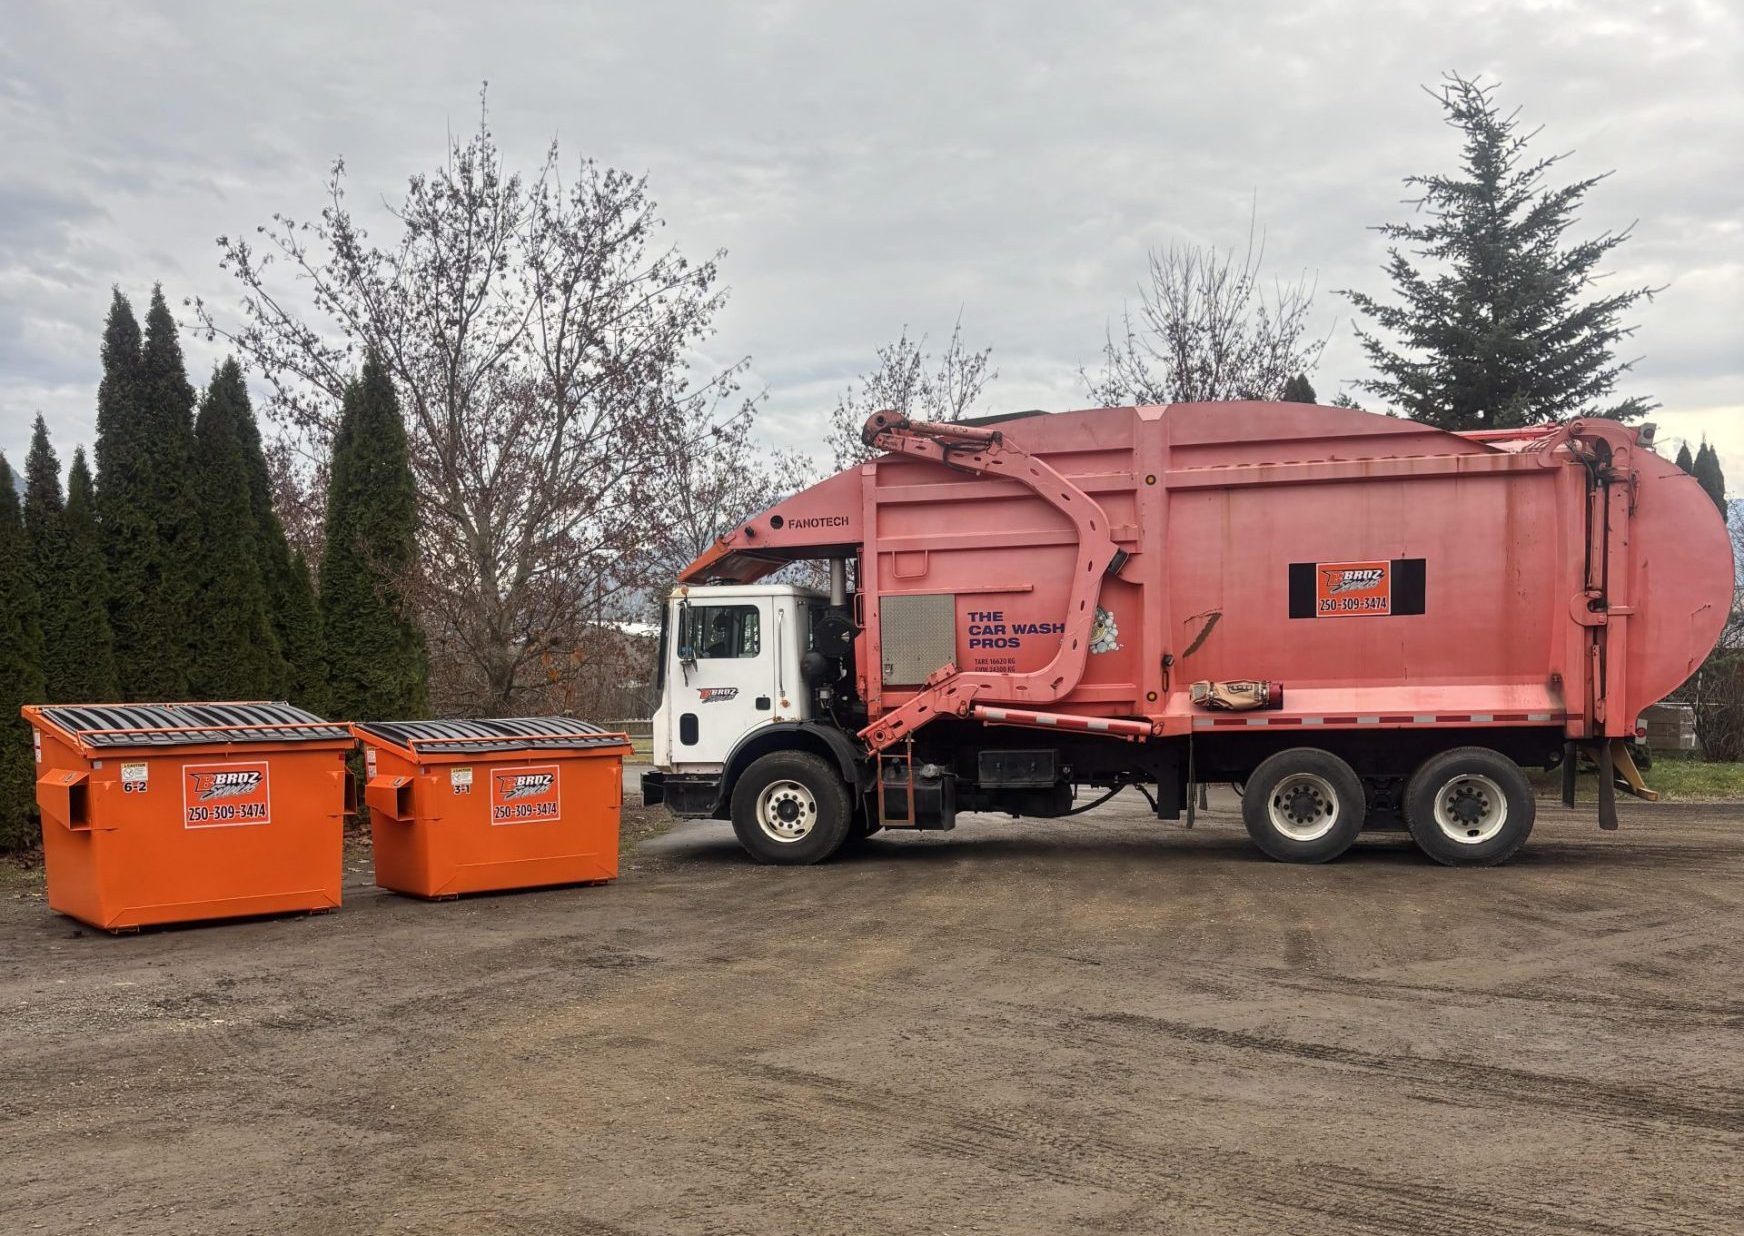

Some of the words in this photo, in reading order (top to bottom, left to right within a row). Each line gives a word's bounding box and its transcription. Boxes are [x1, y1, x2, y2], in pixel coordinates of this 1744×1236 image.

[788, 516, 849, 529] FANOTECH
[1343, 569, 1383, 581] BROZ
[1320, 597, 1387, 611] 250-309-3474
[967, 611, 1004, 622] THE
[968, 624, 1007, 636] CAR
[1012, 623, 1065, 635] WASH
[969, 637, 1021, 649] PROS
[215, 772, 261, 784] BROZ
[516, 774, 553, 786] BROZ
[124, 781, 147, 792] 6-2
[455, 785, 470, 794] 3-1
[189, 804, 266, 821] 250-309-3474
[495, 802, 557, 819] 250-309-3474
